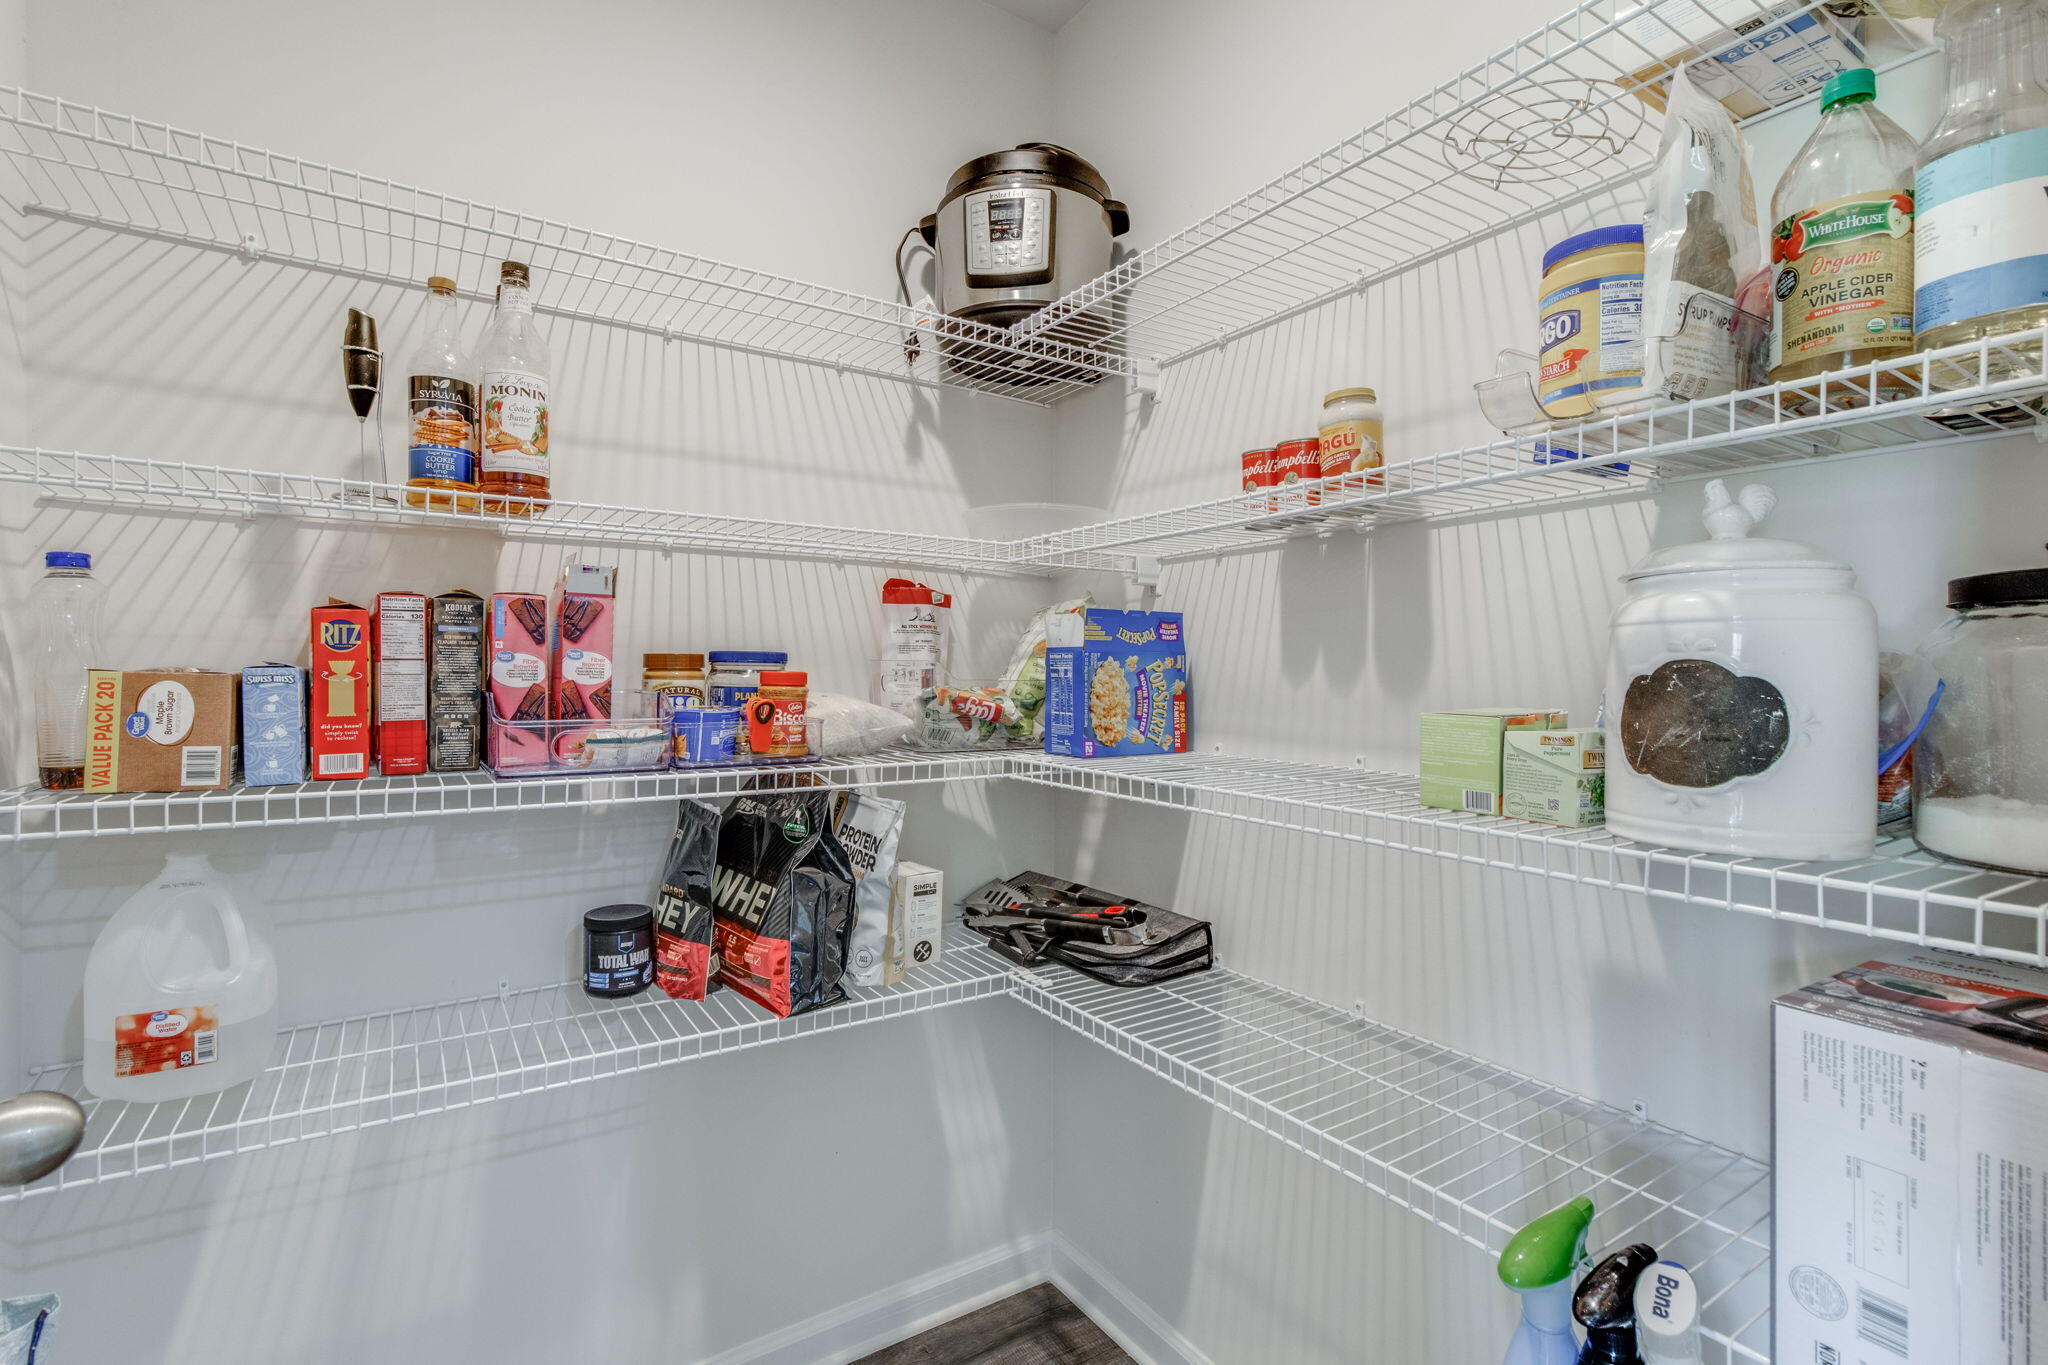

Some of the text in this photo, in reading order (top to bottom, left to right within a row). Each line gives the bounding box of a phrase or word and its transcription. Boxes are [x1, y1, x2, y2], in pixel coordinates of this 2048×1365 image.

[1810, 250, 1882, 275] Organic
[1601, 282, 1628, 290] Nutrition
[1801, 279, 1846, 299] APPLE
[1850, 272, 1894, 286] CIDER
[1809, 285, 1885, 308] VINEGAR
[1601, 306, 1630, 315] Calories
[1814, 309, 1833, 318] WITH
[1540, 315, 1572, 348] RGO
[1787, 323, 1845, 350] SHENANDOAH
[419, 389, 463, 403] SYRUVIA
[490, 384, 547, 402] MONIN
[508, 404, 532, 414] Cookie
[425, 456, 456, 465] COOKIE
[425, 462, 456, 472] BUTTER
[445, 604, 474, 613] KODIAK
[320, 622, 362, 646] RITZ
[155, 701, 165, 725] Maple
[165, 690, 176, 735] Brown Sugar
[1139, 674, 1149, 732] MOVIE THEATER
[91, 681, 115, 788] VALUE PACK 20
[838, 823, 883, 855] PROTEIN
[840, 842, 877, 873] OWDER
[913, 882, 937, 891] SIMPLE
[656, 894, 701, 934] HEY
[598, 947, 650, 970] TOTAL WAR
[155, 1021, 181, 1030] Distilled
[1652, 1274, 1680, 1319] Bona
